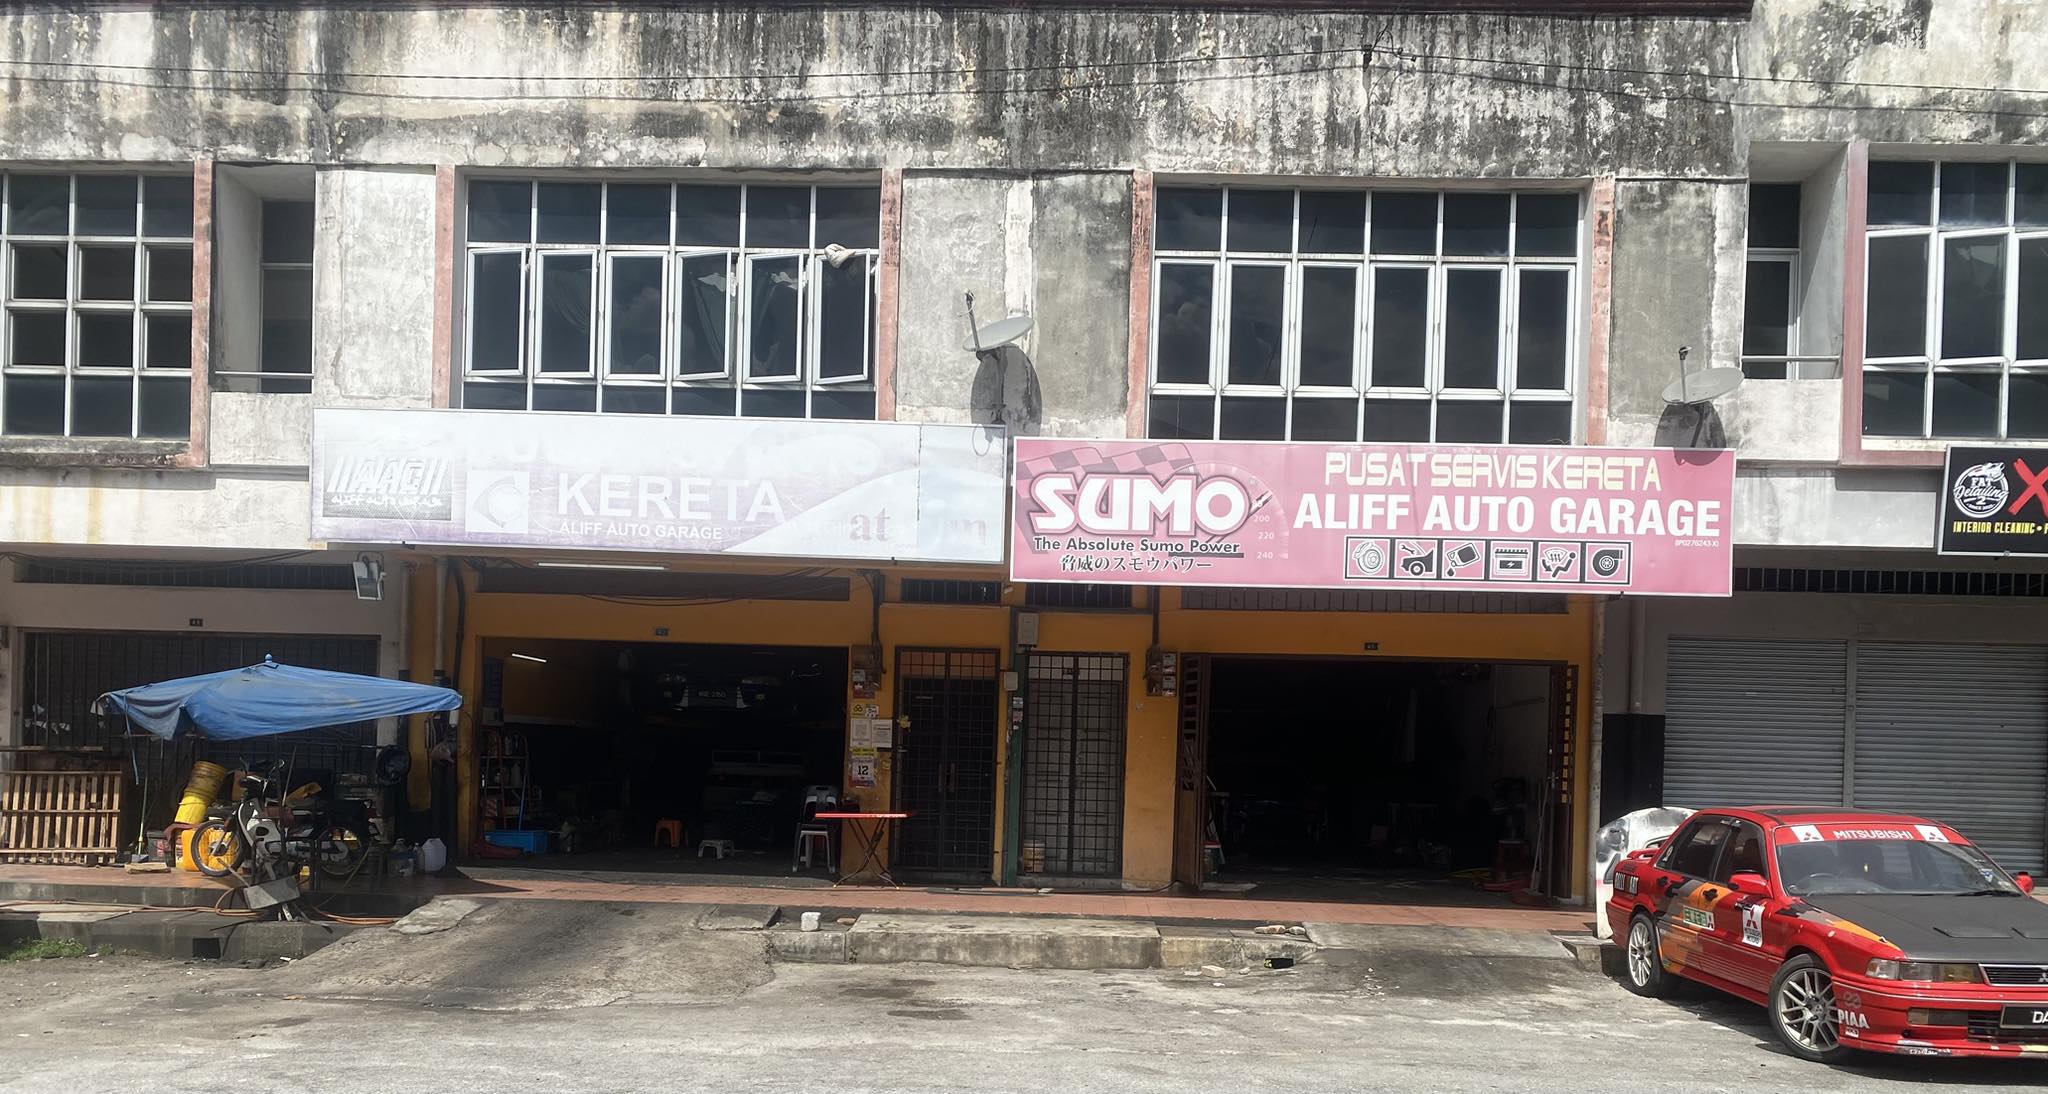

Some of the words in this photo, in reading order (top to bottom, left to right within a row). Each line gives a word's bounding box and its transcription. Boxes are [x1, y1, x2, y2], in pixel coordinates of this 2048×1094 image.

[1325, 452, 1428, 487] PUSAT
[1429, 454, 1538, 489] SERVIS
[1541, 455, 1662, 491] KERETA
[1971, 477, 1992, 487] FAT
[558, 472, 786, 522] KERETA
[1976, 496, 1986, 505] 2
[1029, 474, 1250, 536] SUMO
[1253, 515, 1271, 523] 200
[1293, 493, 1410, 530] ALIFF
[1422, 495, 1535, 534] AUTO
[1550, 497, 1721, 537] GARAGE
[560, 522, 602, 536] ALIFF
[606, 523, 650, 538] AUTO
[655, 525, 723, 541] GARAGE
[1953, 521, 1992, 533] INTERIOR
[1994, 522, 2036, 534] CLEANING
[1258, 531, 1275, 540] 220
[1034, 536, 1061, 551] The
[1066, 537, 1135, 552] Absolute
[1140, 538, 1184, 553] Sumo
[1190, 540, 1241, 554] Power
[1256, 551, 1274, 559] 240
[1060, 554, 1213, 573] 脅威のスモウパワー
[857, 765, 869, 776] 12
[1833, 829, 1914, 840] MITSUBISHI
[1837, 1009, 1870, 1029] PIAA
